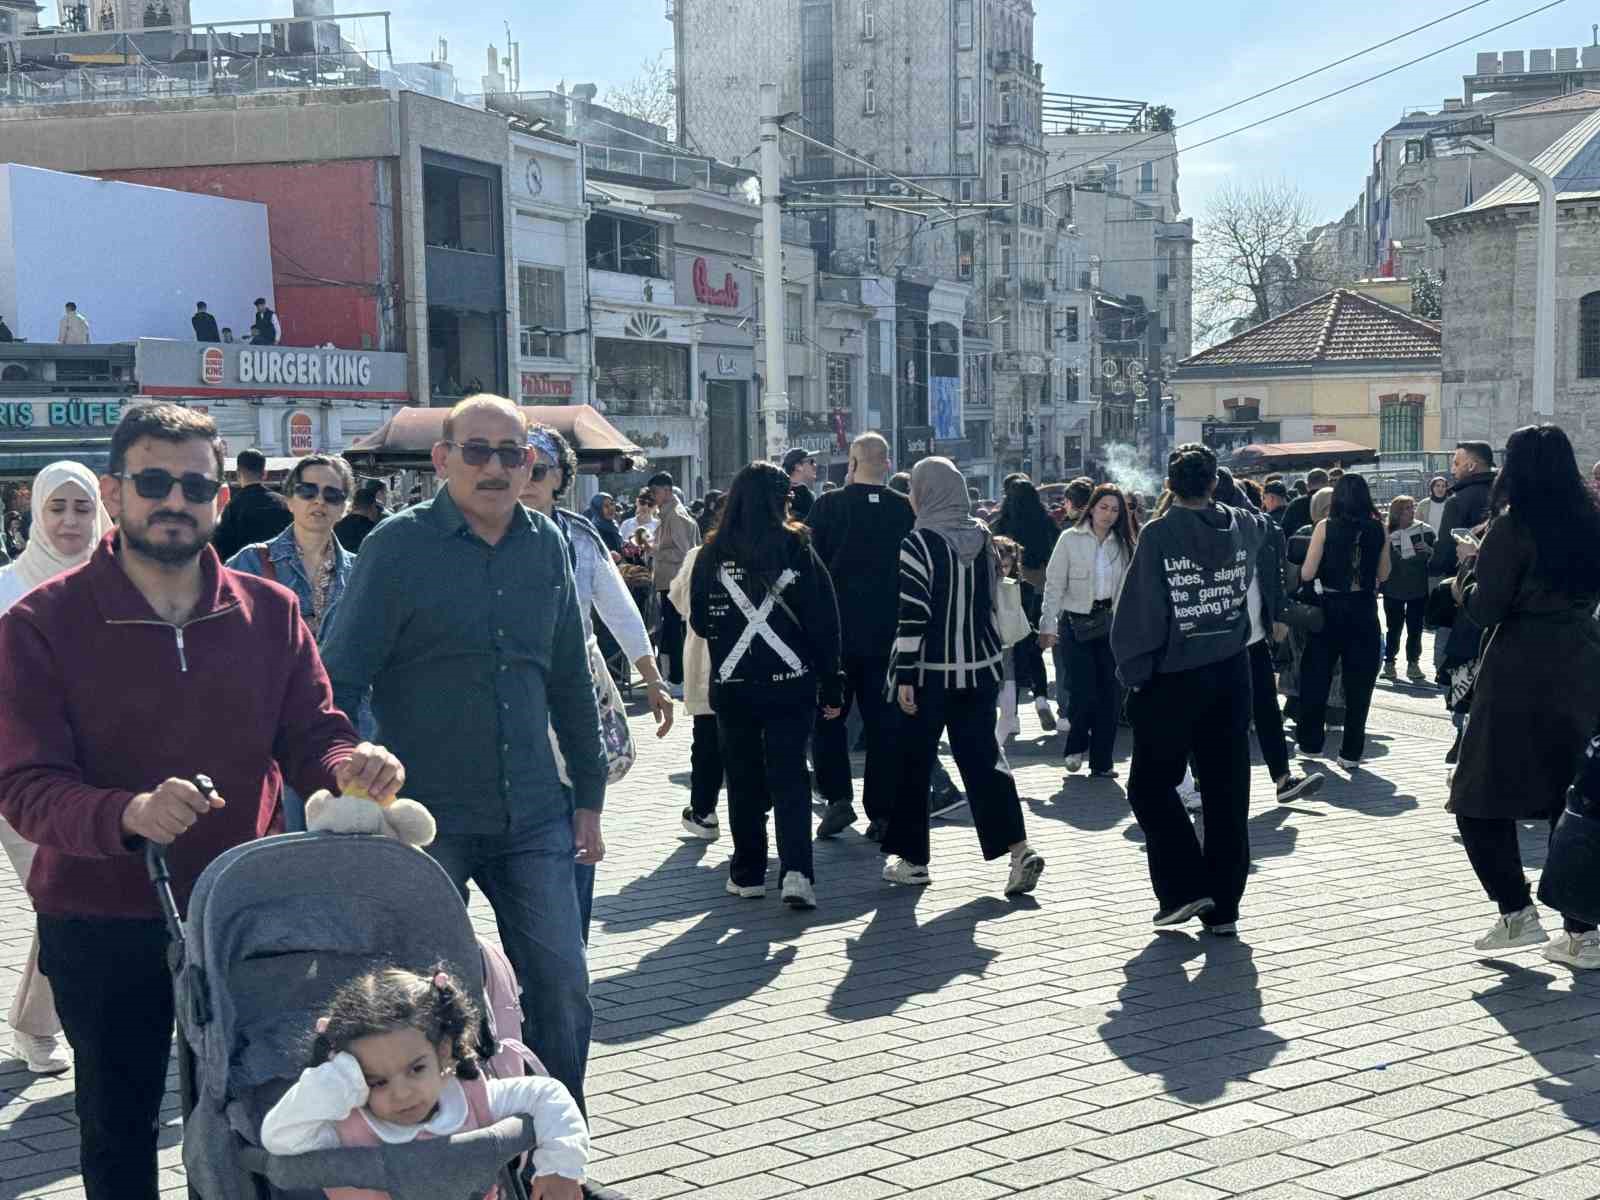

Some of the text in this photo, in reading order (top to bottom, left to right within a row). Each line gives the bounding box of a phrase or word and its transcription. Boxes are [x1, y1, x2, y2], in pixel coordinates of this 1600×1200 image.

[205, 367, 223, 377] KING
[239, 350, 371, 386] BURGER KING
[50, 399, 120, 425] BÜFE
[291, 435, 312, 448] KING
[1167, 565, 1246, 587] vibes, slaying
[1171, 589, 1189, 603] the
[1198, 585, 1234, 602] game,
[1174, 601, 1221, 619] keeping
